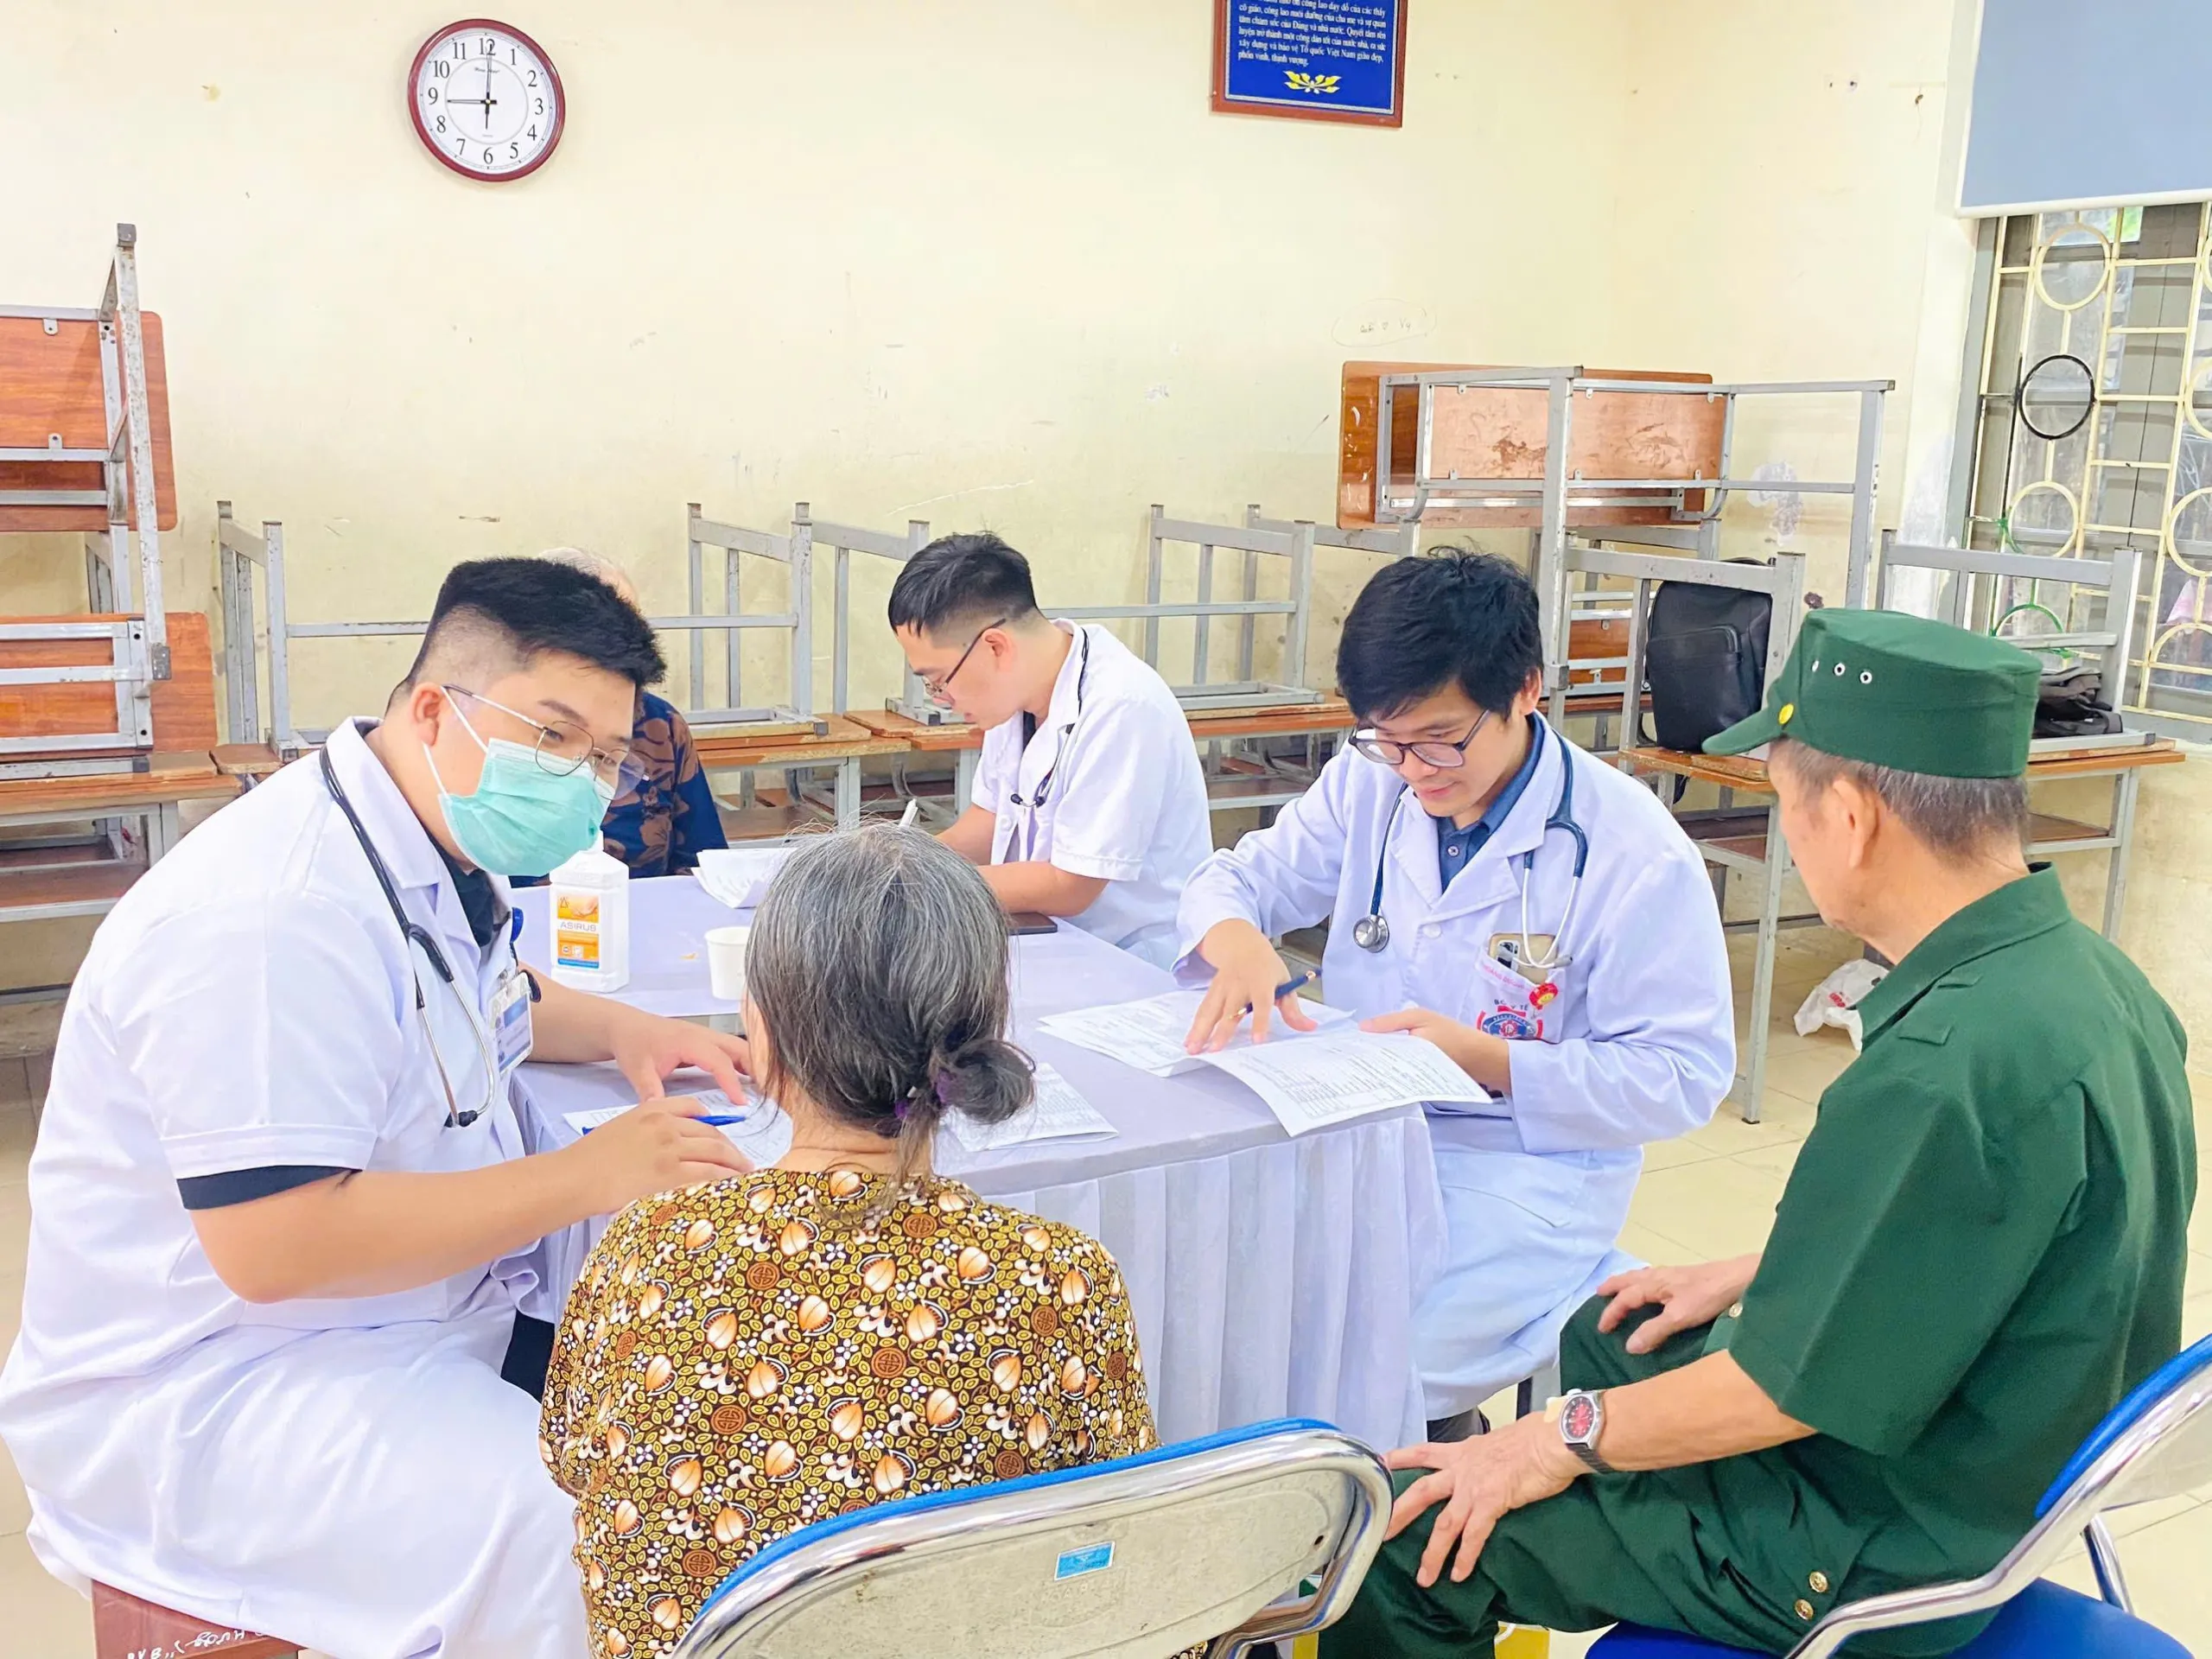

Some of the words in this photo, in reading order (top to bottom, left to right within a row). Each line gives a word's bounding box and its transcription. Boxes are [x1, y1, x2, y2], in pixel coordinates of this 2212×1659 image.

[1280, 7, 1289, 16] lao
[1357, 17, 1363, 25] và
[1350, 4, 1360, 13] của
[1362, 5, 1372, 14] các
[453, 42, 467, 60] 11
[479, 38, 496, 56] 12
[1327, 47, 1339, 58] Việt
[1341, 49, 1356, 58] Nam
[511, 48, 517, 65] 1
[434, 60, 450, 78] 10
[528, 70, 537, 87] 2
[428, 87, 438, 105] 9
[534, 98, 543, 115] 3
[437, 115, 446, 133] 8
[527, 124, 537, 141] 4
[456, 138, 465, 155] 7
[483, 147, 493, 163] 6
[510, 142, 518, 159] 5
[561, 921, 597, 932] ASIRUS
